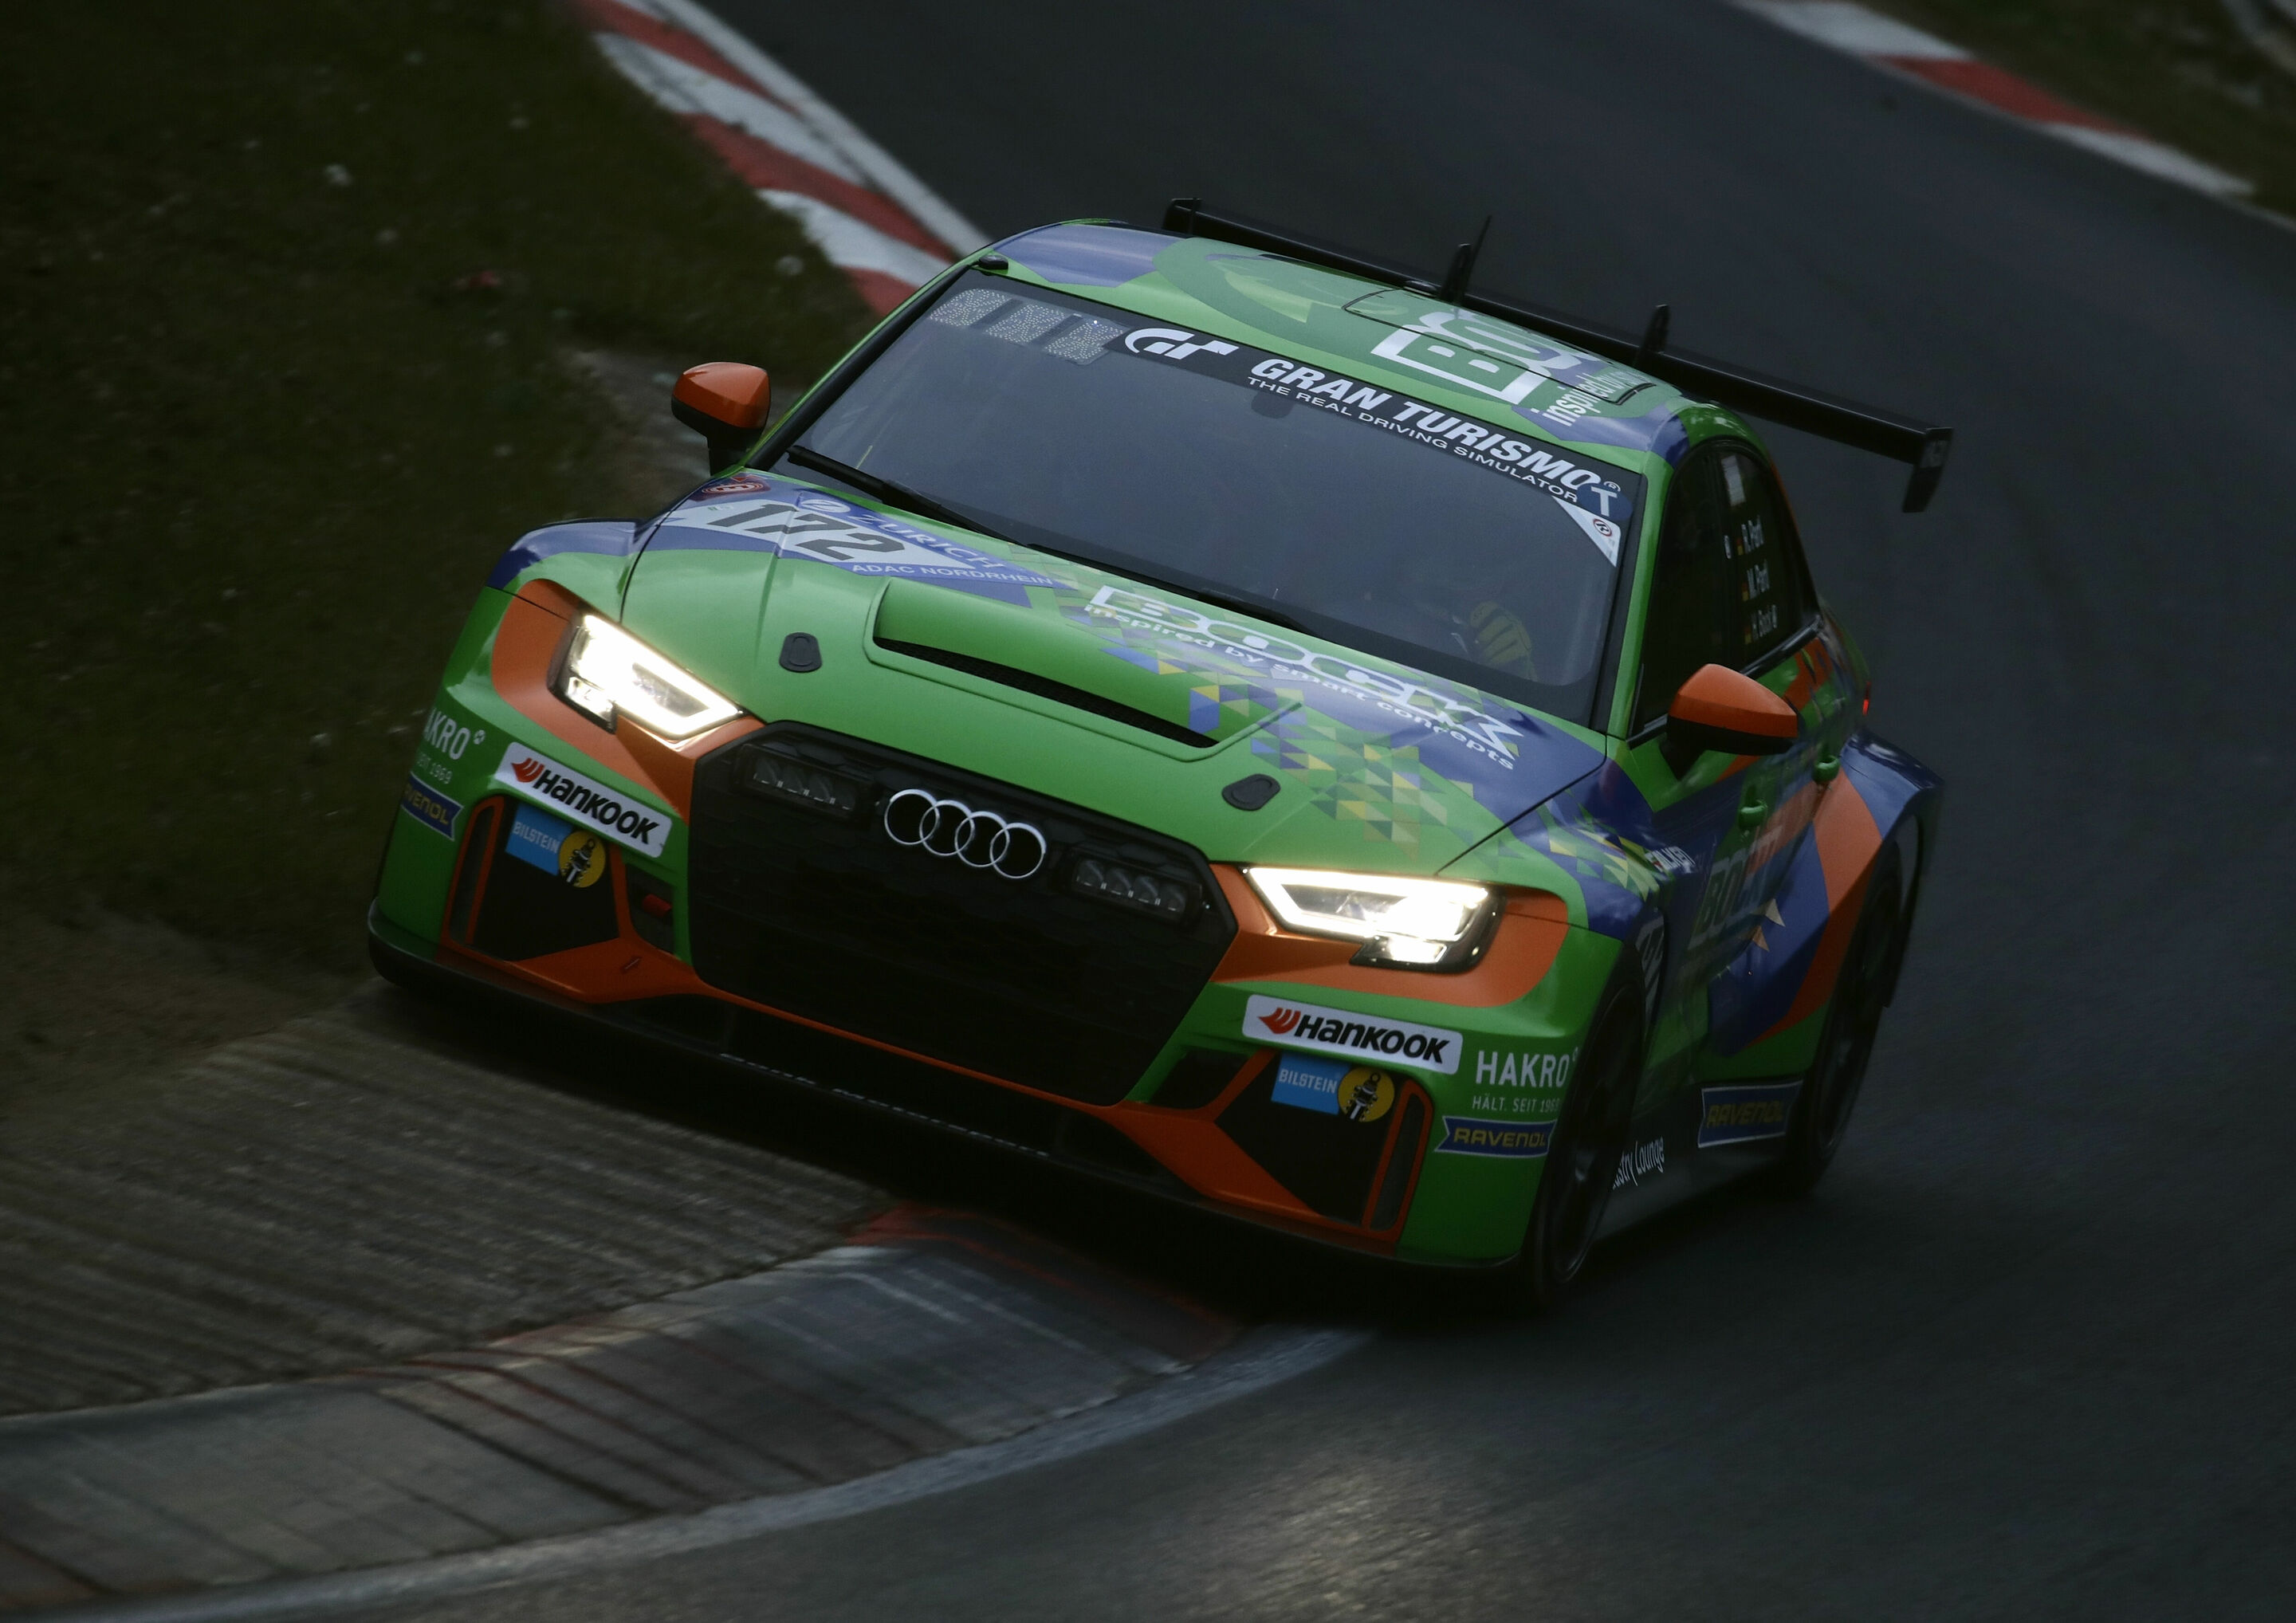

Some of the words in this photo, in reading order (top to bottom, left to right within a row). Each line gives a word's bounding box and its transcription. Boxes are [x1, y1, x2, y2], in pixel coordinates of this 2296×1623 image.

[1248, 376, 1288, 395] THE
[1295, 393, 1352, 417] REAL
[1358, 412, 1448, 449] DRIVING
[1453, 447, 1578, 502] SIMULATOR
[1251, 359, 1393, 411] GRAN
[1394, 402, 1602, 489] TURISMO
[1590, 486, 1618, 517] T
[707, 504, 905, 560] 172
[847, 514, 1004, 568] ZURICH
[852, 564, 914, 574] ADAC
[922, 567, 1054, 585] NORDRHEIN
[1084, 604, 1215, 648] inspired
[1225, 646, 1264, 662] by
[1273, 663, 1369, 701] smart
[1378, 701, 1513, 770] concepts
[513, 820, 560, 854] BILSTEIN
[1279, 1069, 1338, 1094] BILSTEIN
[1476, 1050, 1570, 1088] HAKRO
[1512, 1098, 1537, 1113] SEIT
[1453, 1127, 1546, 1147] RAVENOL
[1635, 1136, 1665, 1173] Lounge
